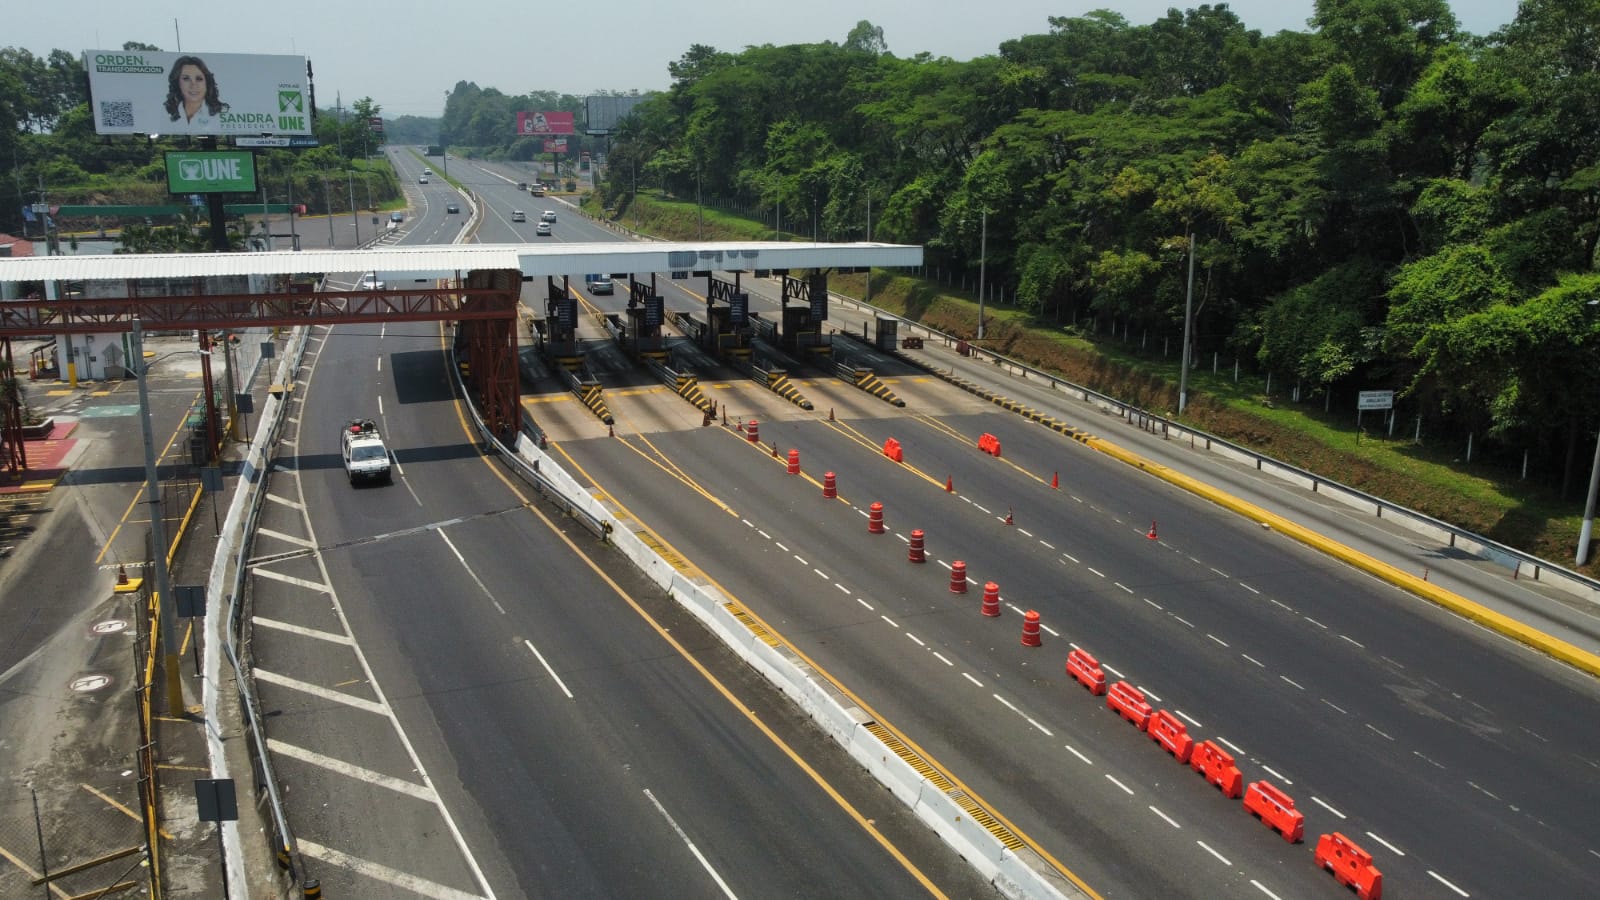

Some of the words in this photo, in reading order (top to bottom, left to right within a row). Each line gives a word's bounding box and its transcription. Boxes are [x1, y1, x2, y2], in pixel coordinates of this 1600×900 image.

[95, 54, 144, 66] ORDEN
[220, 113, 274, 123] SANDRA
[278, 116, 305, 130] UNE
[203, 158, 242, 180] UNE
